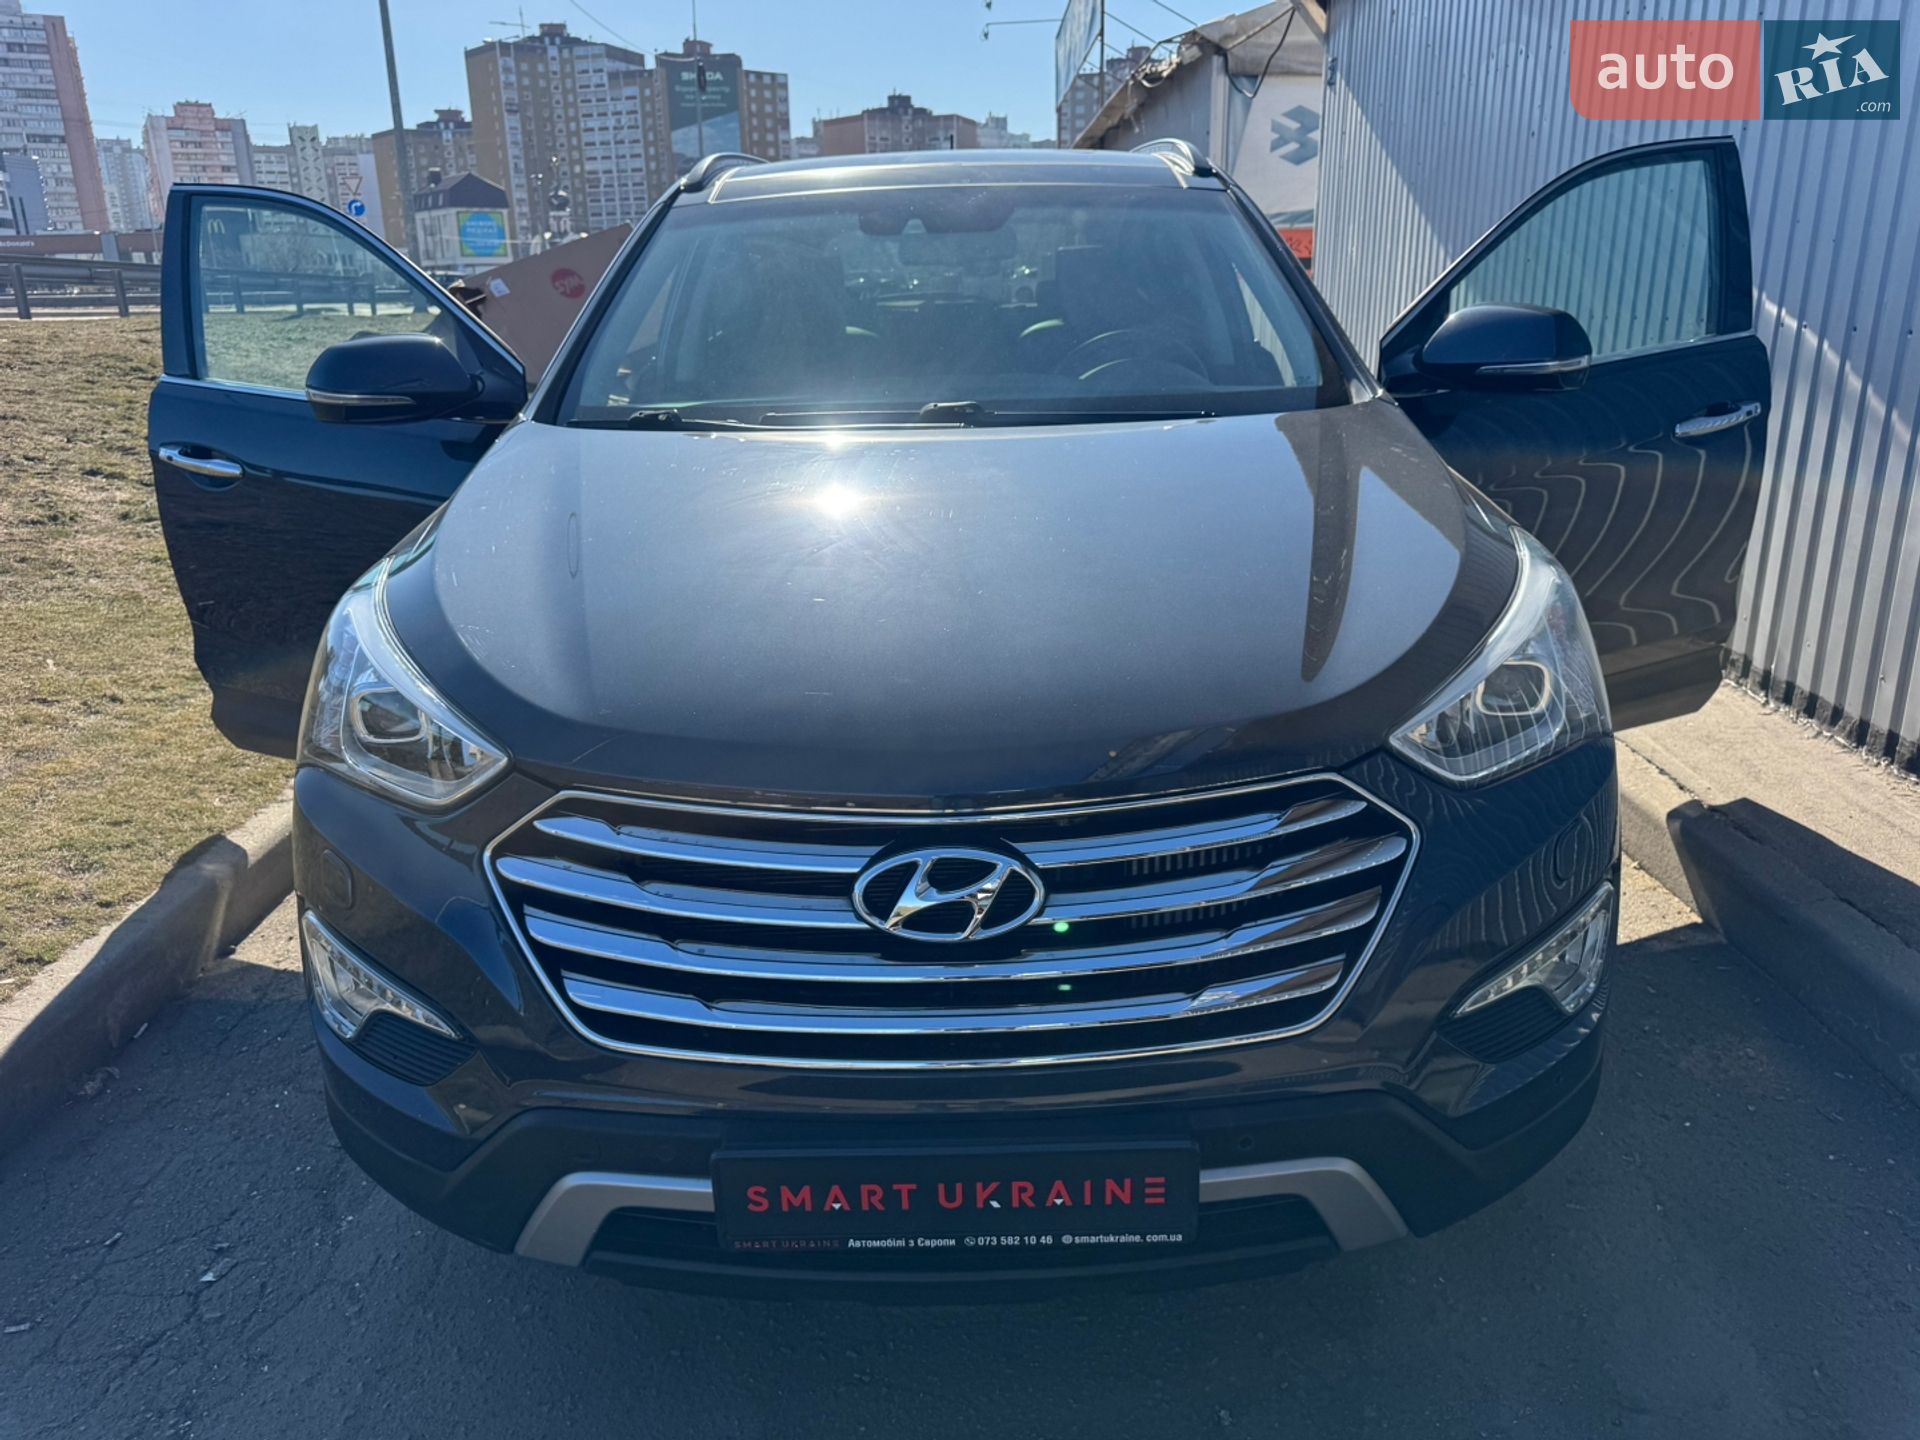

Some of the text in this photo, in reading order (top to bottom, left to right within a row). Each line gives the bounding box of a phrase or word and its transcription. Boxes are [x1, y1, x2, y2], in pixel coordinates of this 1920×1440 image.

[746, 1176, 1165, 1212] SMART UKRAINE
[847, 1237, 906, 1248] Автомобілі
[977, 1236, 998, 1246] 073
[1023, 1235, 1037, 1245] 10
